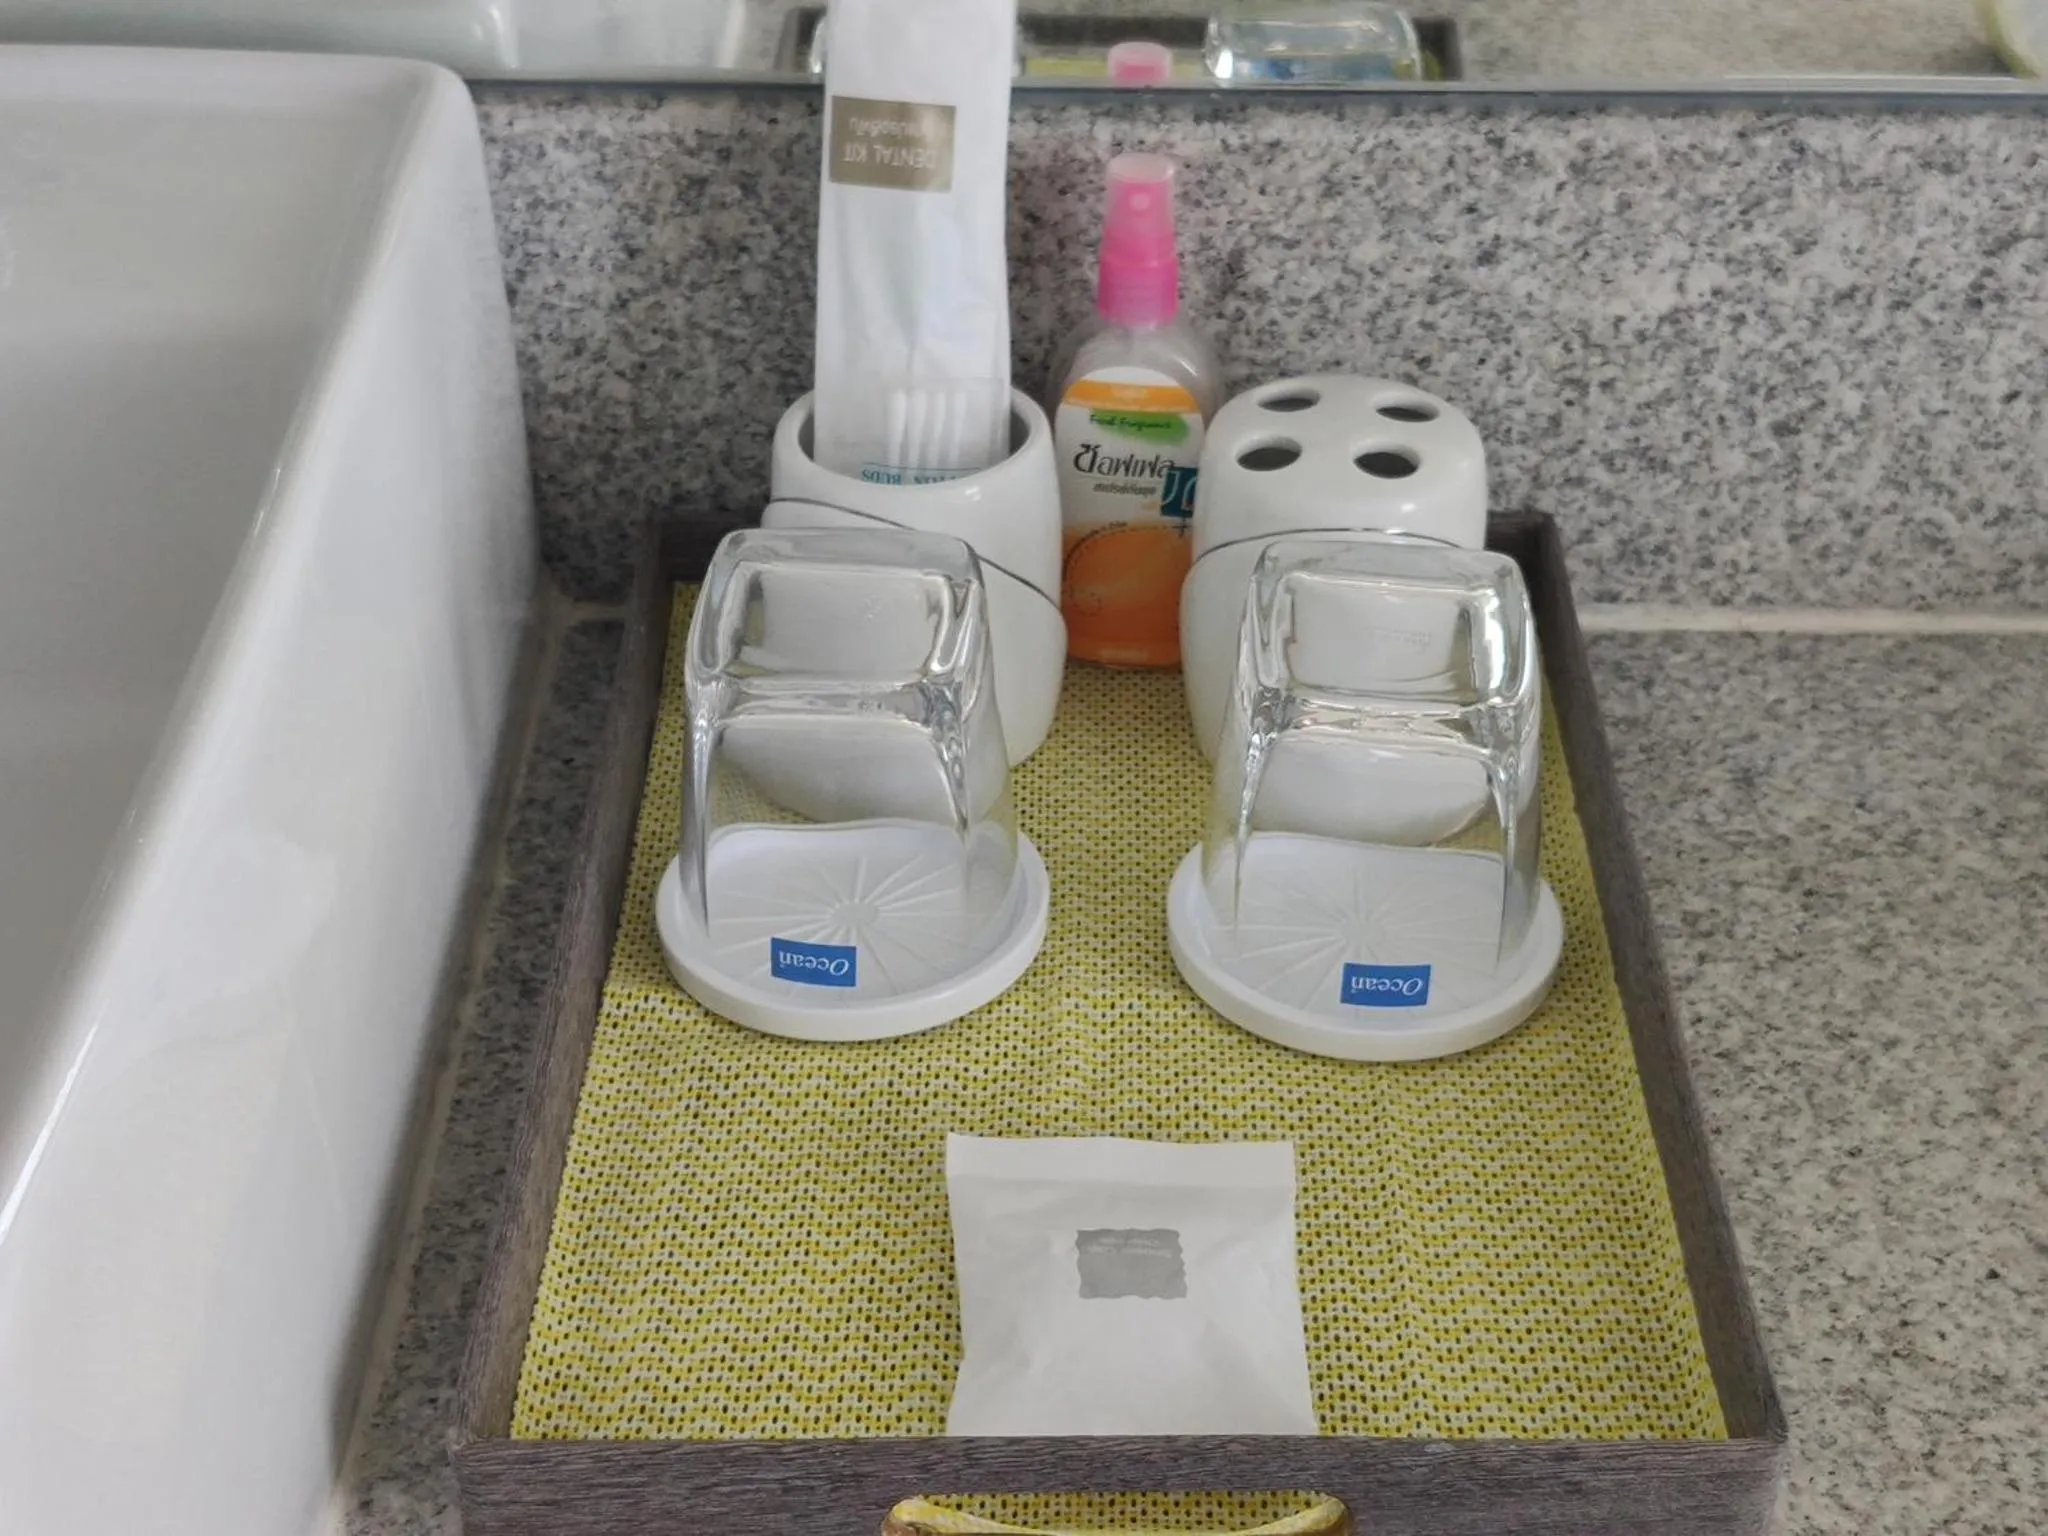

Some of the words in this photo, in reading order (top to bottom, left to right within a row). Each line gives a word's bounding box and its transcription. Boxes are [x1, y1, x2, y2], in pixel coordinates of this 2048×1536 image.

[842, 141, 868, 164] KIT
[872, 144, 938, 169] DENTAL
[779, 950, 850, 977] Ocean
[1350, 976, 1423, 997] Ocean
